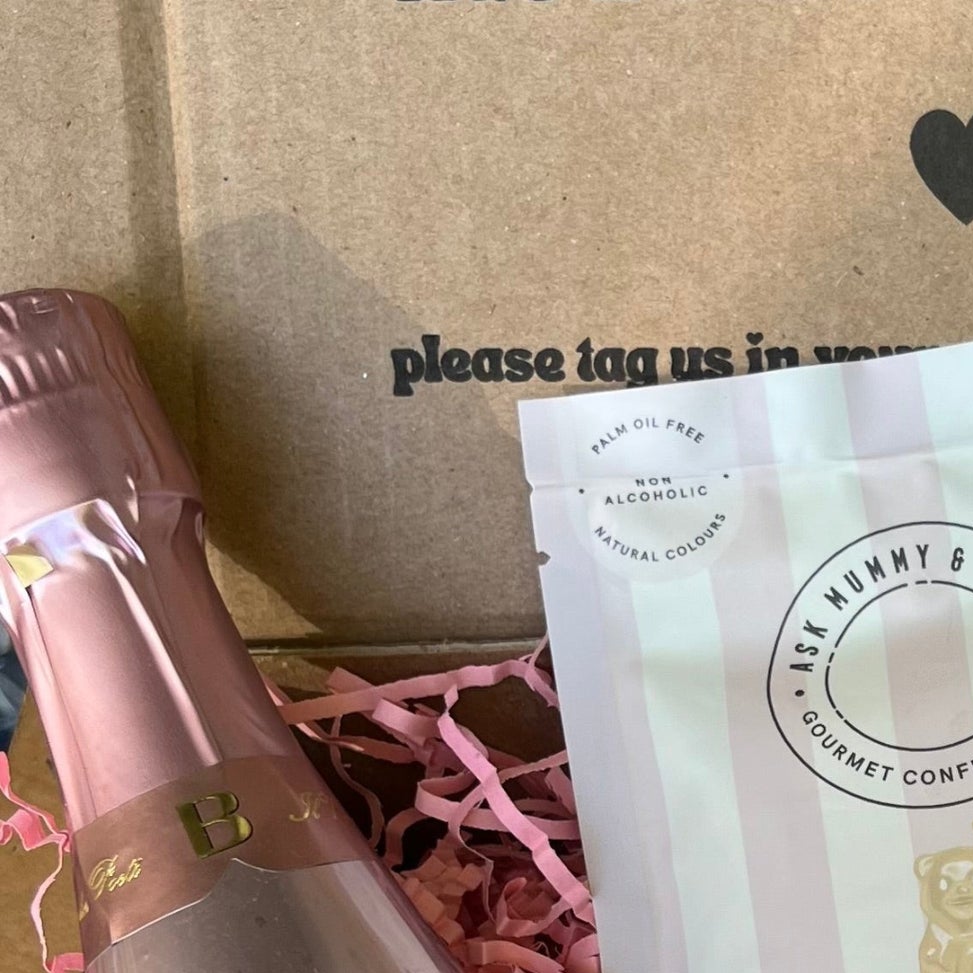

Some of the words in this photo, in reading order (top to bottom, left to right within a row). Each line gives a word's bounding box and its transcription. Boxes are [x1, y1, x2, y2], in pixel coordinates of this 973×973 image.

[390, 334, 567, 397] please
[576, 336, 660, 387] tag
[671, 346, 732, 380] us
[591, 424, 628, 455] PALM
[633, 417, 659, 430] OIL
[666, 419, 704, 444] FREE
[604, 485, 708, 506] ALCOHOLIC
[635, 477, 672, 487] NON
[594, 526, 660, 563] NATURAL
[665, 513, 726, 561] COLOURS
[790, 620, 828, 673] ASK
[824, 544, 930, 610] MUMMY
[950, 547, 965, 572] &
[802, 710, 894, 782] GOURMET
[174, 791, 253, 860] B
